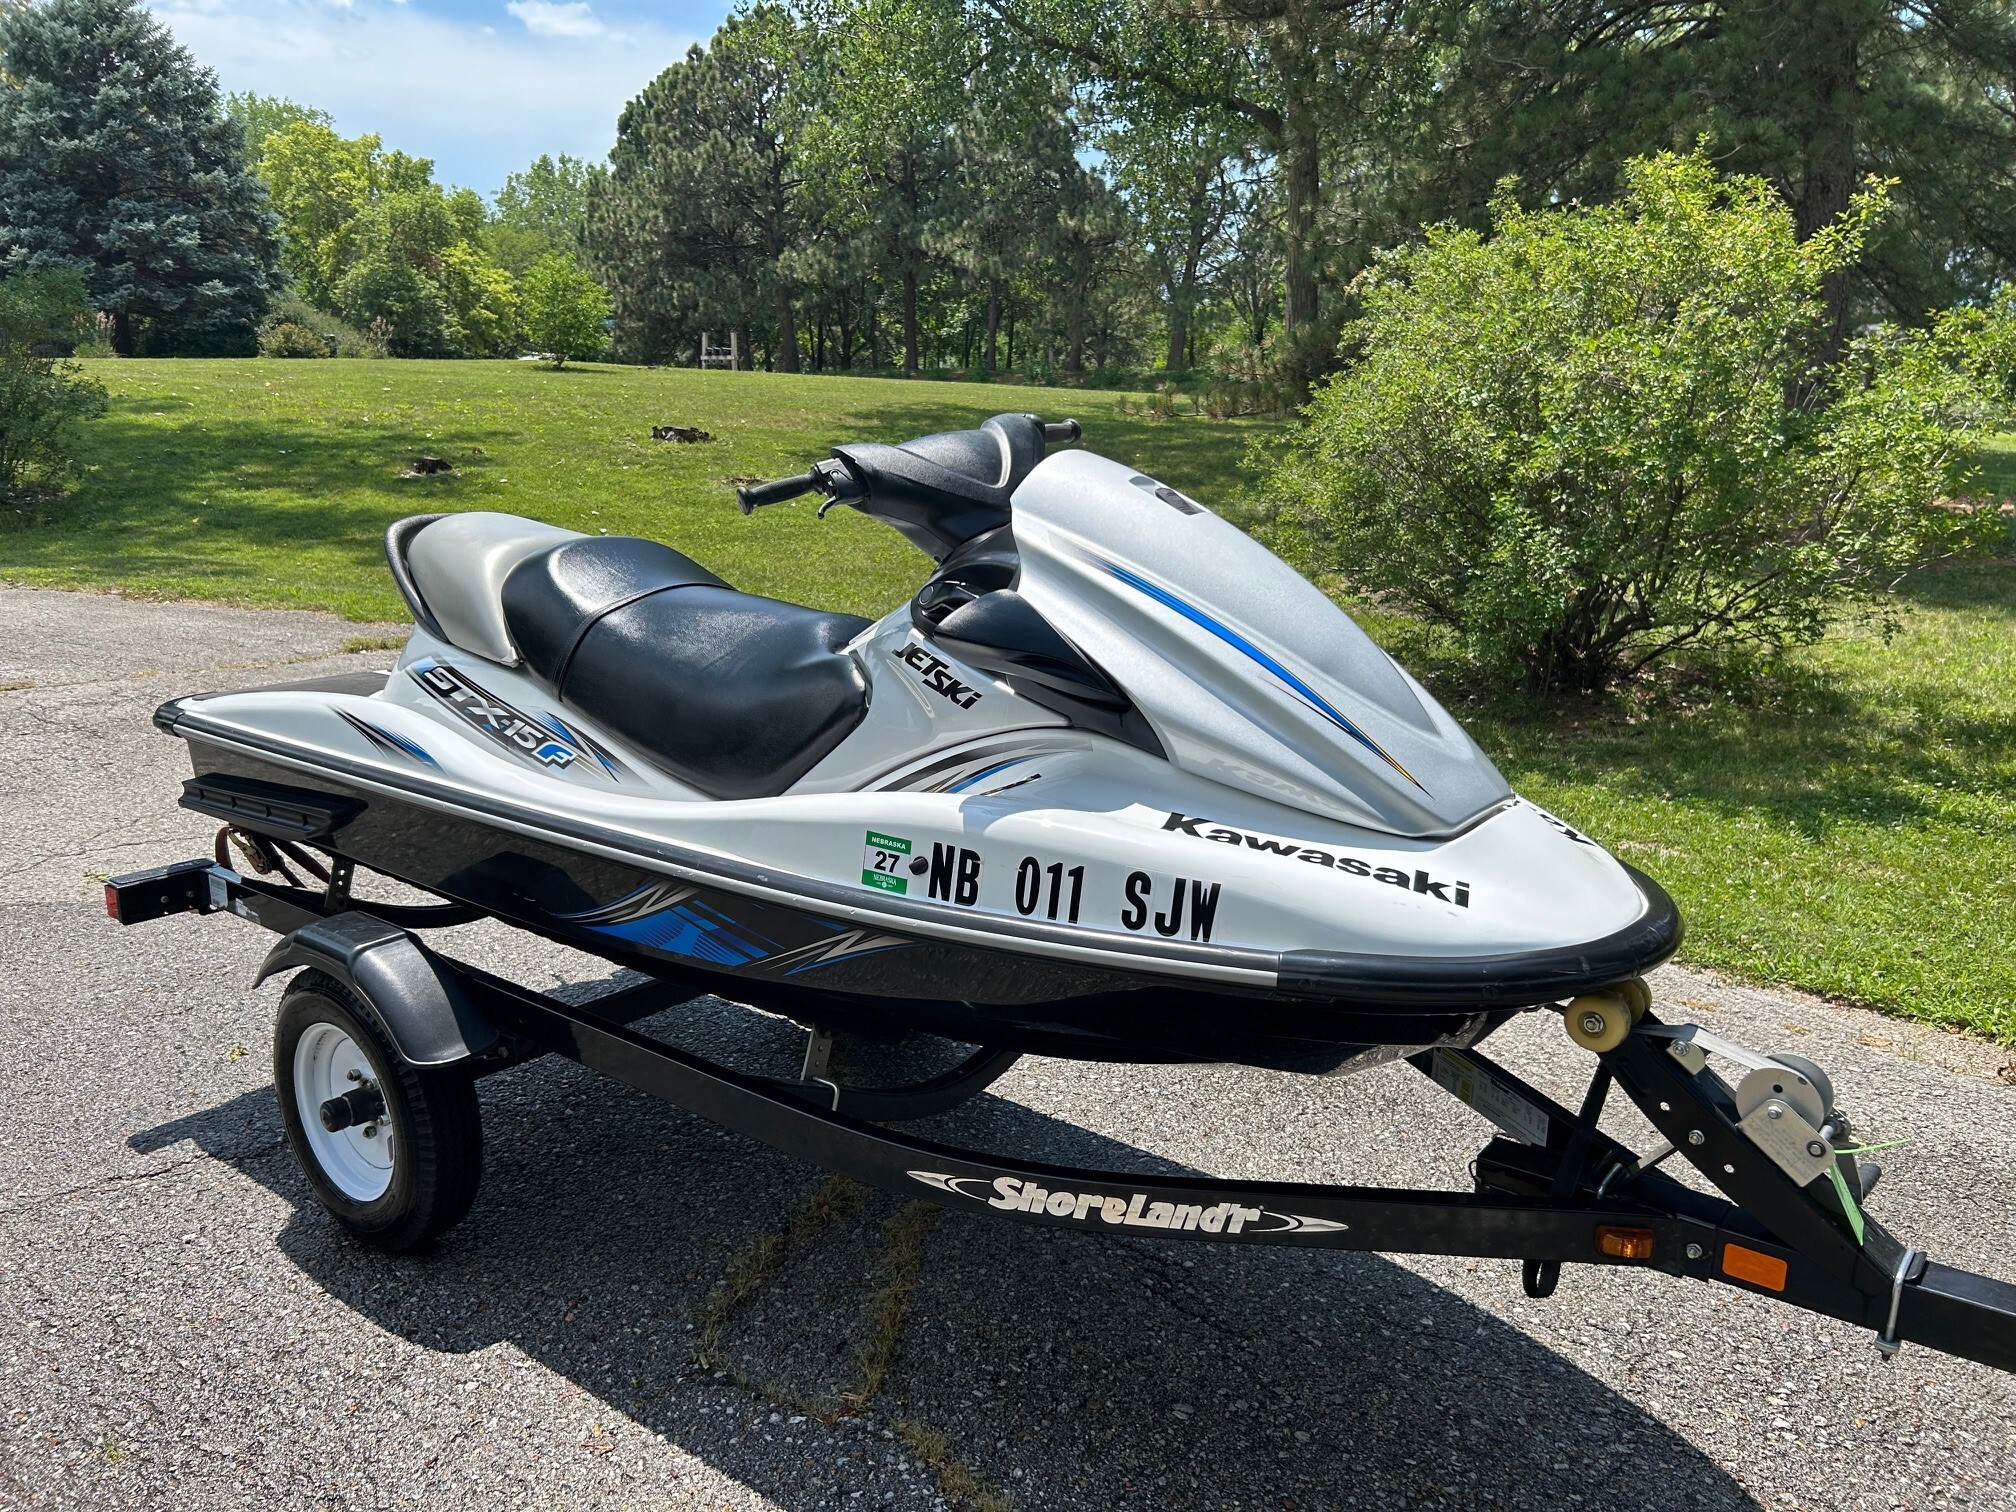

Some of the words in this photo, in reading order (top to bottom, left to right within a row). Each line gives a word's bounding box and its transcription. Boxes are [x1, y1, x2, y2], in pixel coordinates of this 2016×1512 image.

[871, 836, 906, 850] NEBRASKA
[873, 850, 900, 873] 27
[1161, 811, 1470, 908] Kawasaki
[873, 873, 897, 886] NEBRASKA
[928, 842, 982, 907] NB
[1015, 856, 1085, 924] 011
[1121, 871, 1221, 942] SJW
